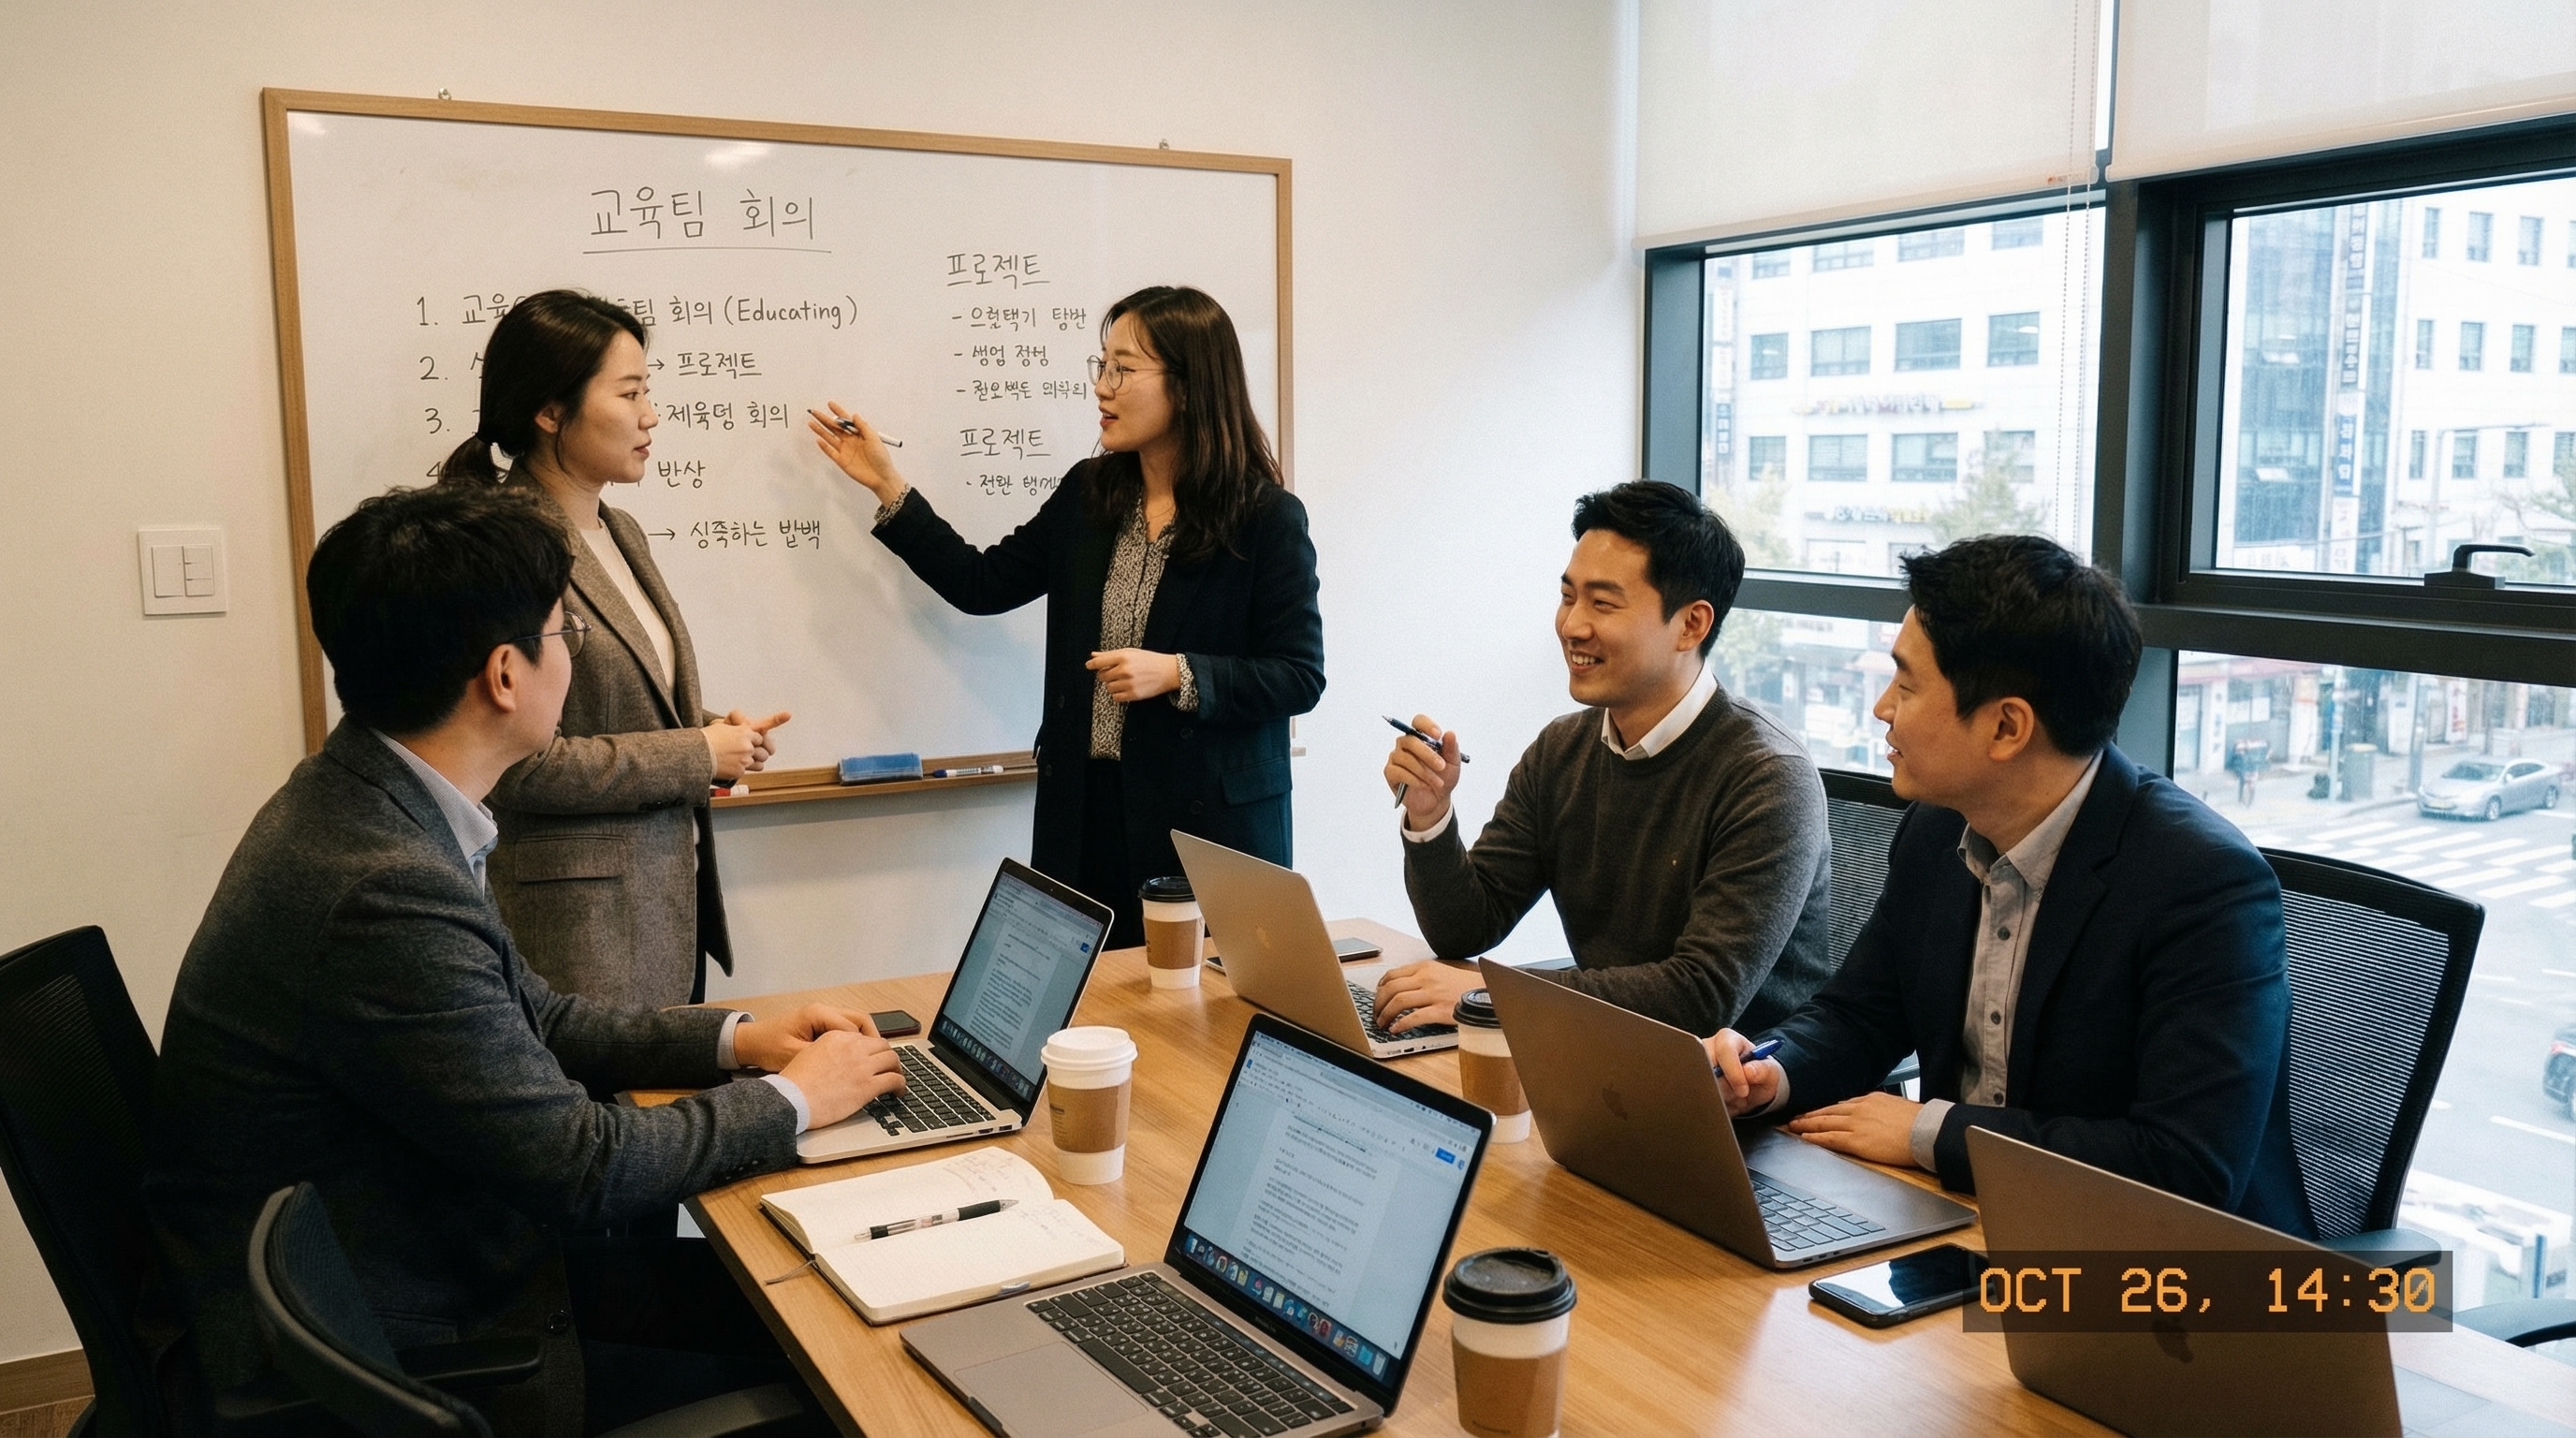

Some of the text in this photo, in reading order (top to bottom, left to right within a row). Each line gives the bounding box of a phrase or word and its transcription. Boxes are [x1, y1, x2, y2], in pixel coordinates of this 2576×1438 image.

[590, 185, 813, 241] 교육팀 회의
[946, 253, 1051, 290] 프로젝트
[416, 296, 440, 327] 1.
[668, 295, 713, 326] 회의
[724, 294, 858, 330] (Educating)
[417, 355, 449, 382] 2.
[677, 351, 763, 380] 프로젝트
[424, 407, 452, 435] 3.
[746, 400, 790, 429] 회의
[959, 427, 1051, 461] 프로젝트
[657, 459, 707, 490] 반상
